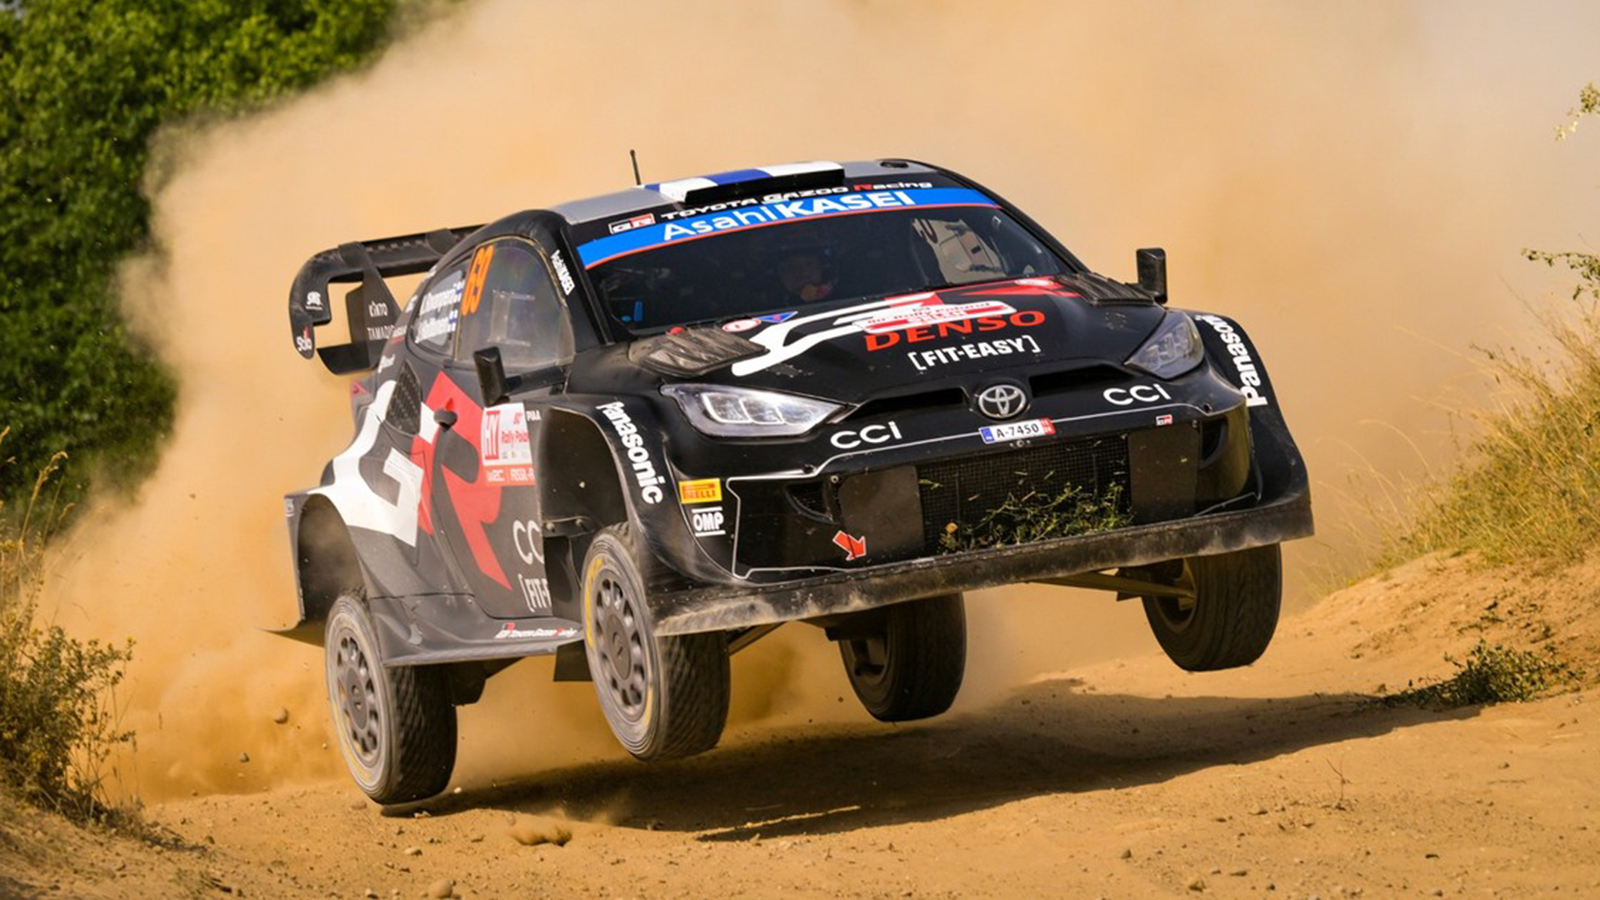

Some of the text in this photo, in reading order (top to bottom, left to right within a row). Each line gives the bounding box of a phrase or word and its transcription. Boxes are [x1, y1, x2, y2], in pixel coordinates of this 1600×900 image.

[661, 181, 933, 220] TOYOTA GAZOO Racing
[863, 310, 1046, 352] DENSO
[1102, 383, 1172, 406] CCI
[829, 421, 903, 449] CCI
[996, 423, 1040, 439] A-7450
[595, 400, 667, 505] Panasonic
[681, 482, 717, 500] PIRELLI
[692, 510, 725, 532] OMP
